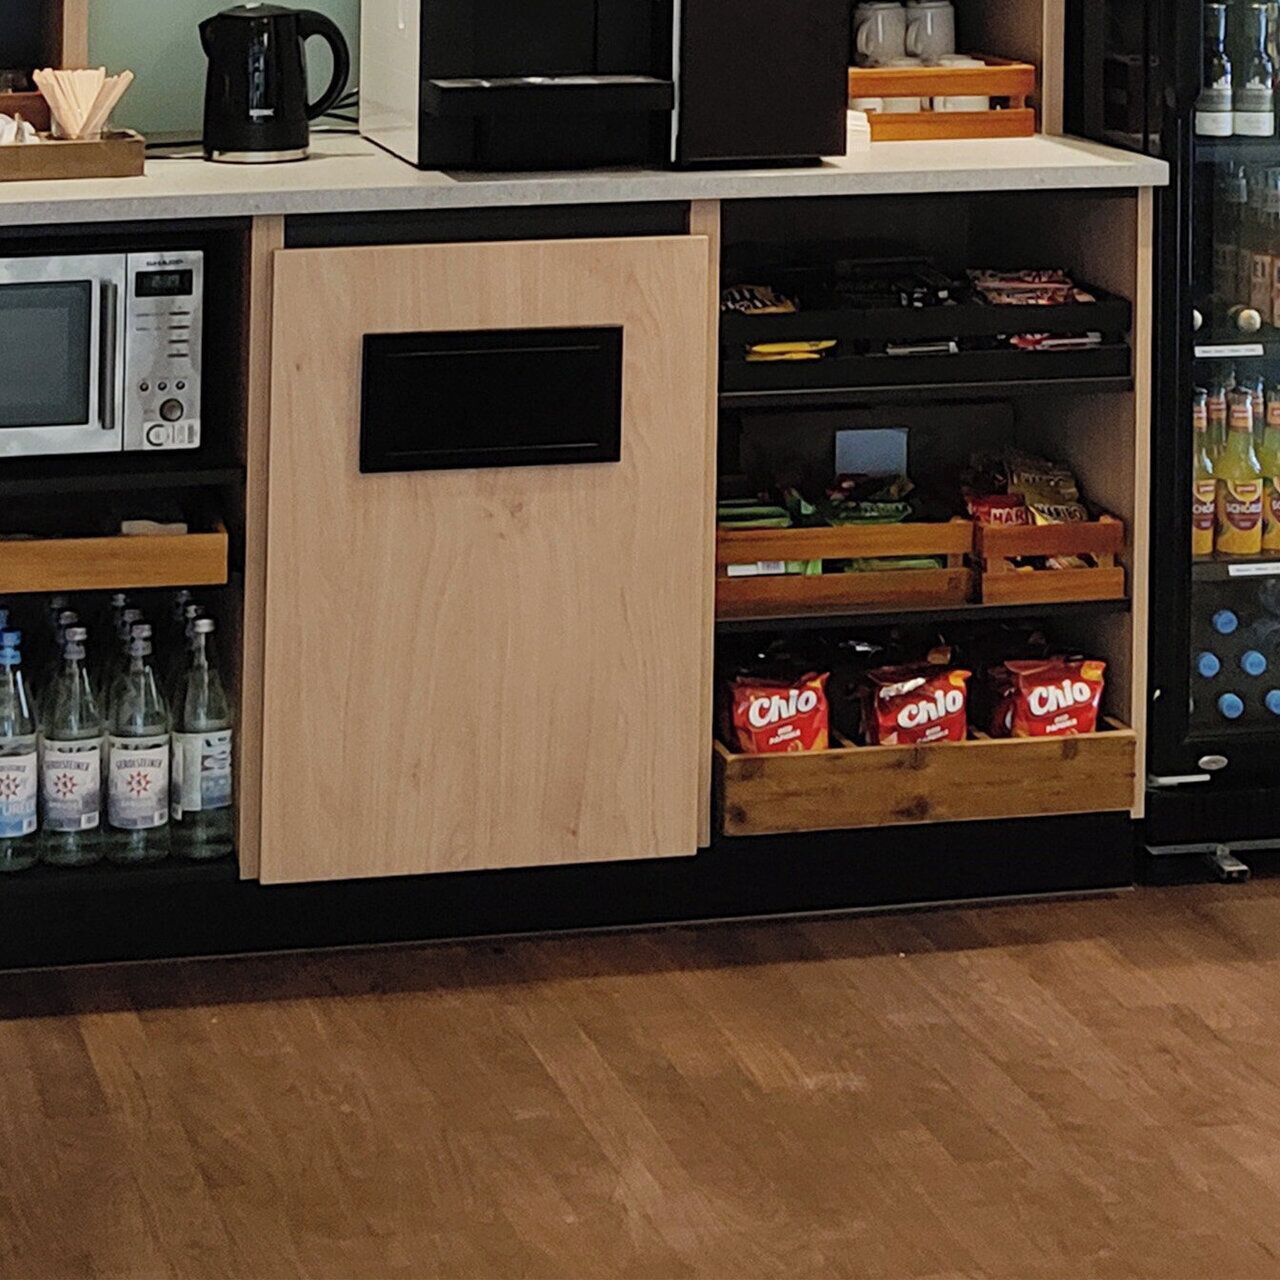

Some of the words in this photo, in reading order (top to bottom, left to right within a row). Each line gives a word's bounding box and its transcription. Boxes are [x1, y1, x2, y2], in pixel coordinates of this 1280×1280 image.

[748, 688, 818, 728] Chio
[896, 689, 964, 729] Chio
[1028, 678, 1091, 716] Chio
